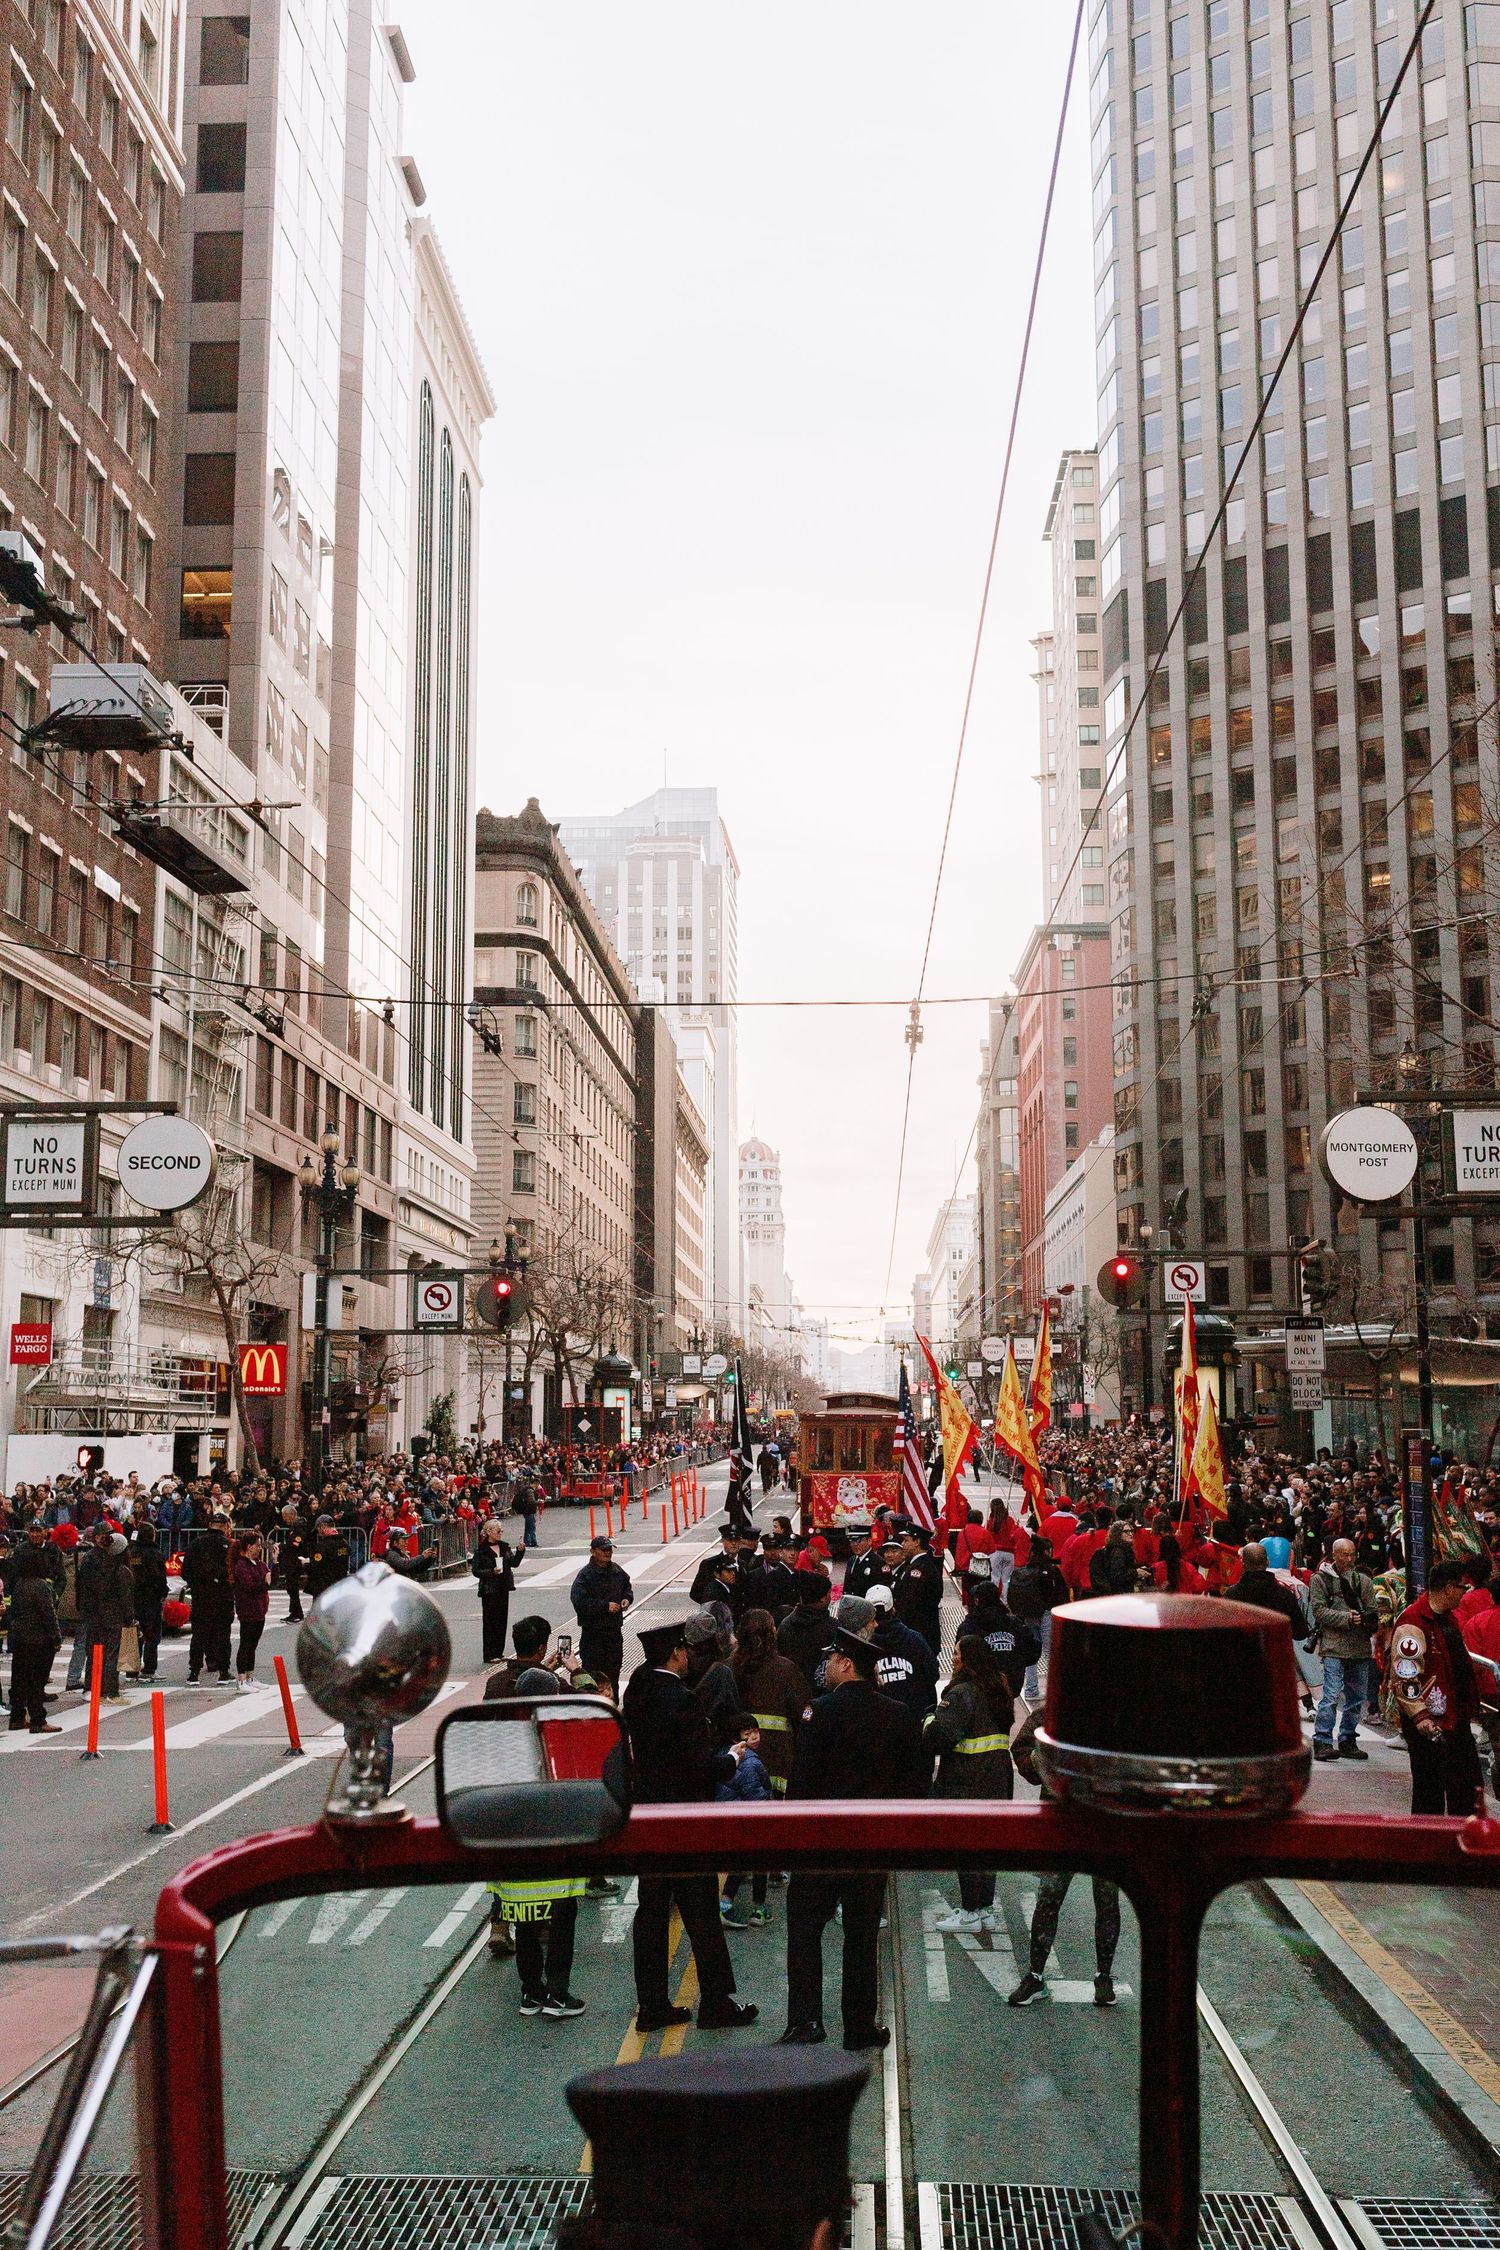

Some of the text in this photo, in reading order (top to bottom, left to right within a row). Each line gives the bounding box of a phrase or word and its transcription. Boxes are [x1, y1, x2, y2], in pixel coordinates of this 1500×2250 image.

[33, 1138, 58, 1153] NO
[1330, 1143, 1414, 1153] MONTGOMERY
[1462, 1146, 1500, 1163] TUR
[14, 1157, 77, 1174] TURNS
[128, 1156, 201, 1170] SECOND
[1359, 1158, 1388, 1167] POST
[1463, 1167, 1500, 1179] EXCEPT
[12, 1179, 77, 1191] EXCEPT MUNI
[15, 1335, 48, 1343] WELLS
[1294, 1334, 1316, 1343] MUNI
[15, 1345, 47, 1353] FARGO
[1293, 1347, 1316, 1355] ONLY
[1292, 1376, 1320, 1386] DO NOT
[1293, 1389, 1321, 1399] BLOCK
[877, 1656, 914, 1675] KLAND
[501, 1901, 552, 1922] BENITEZ
